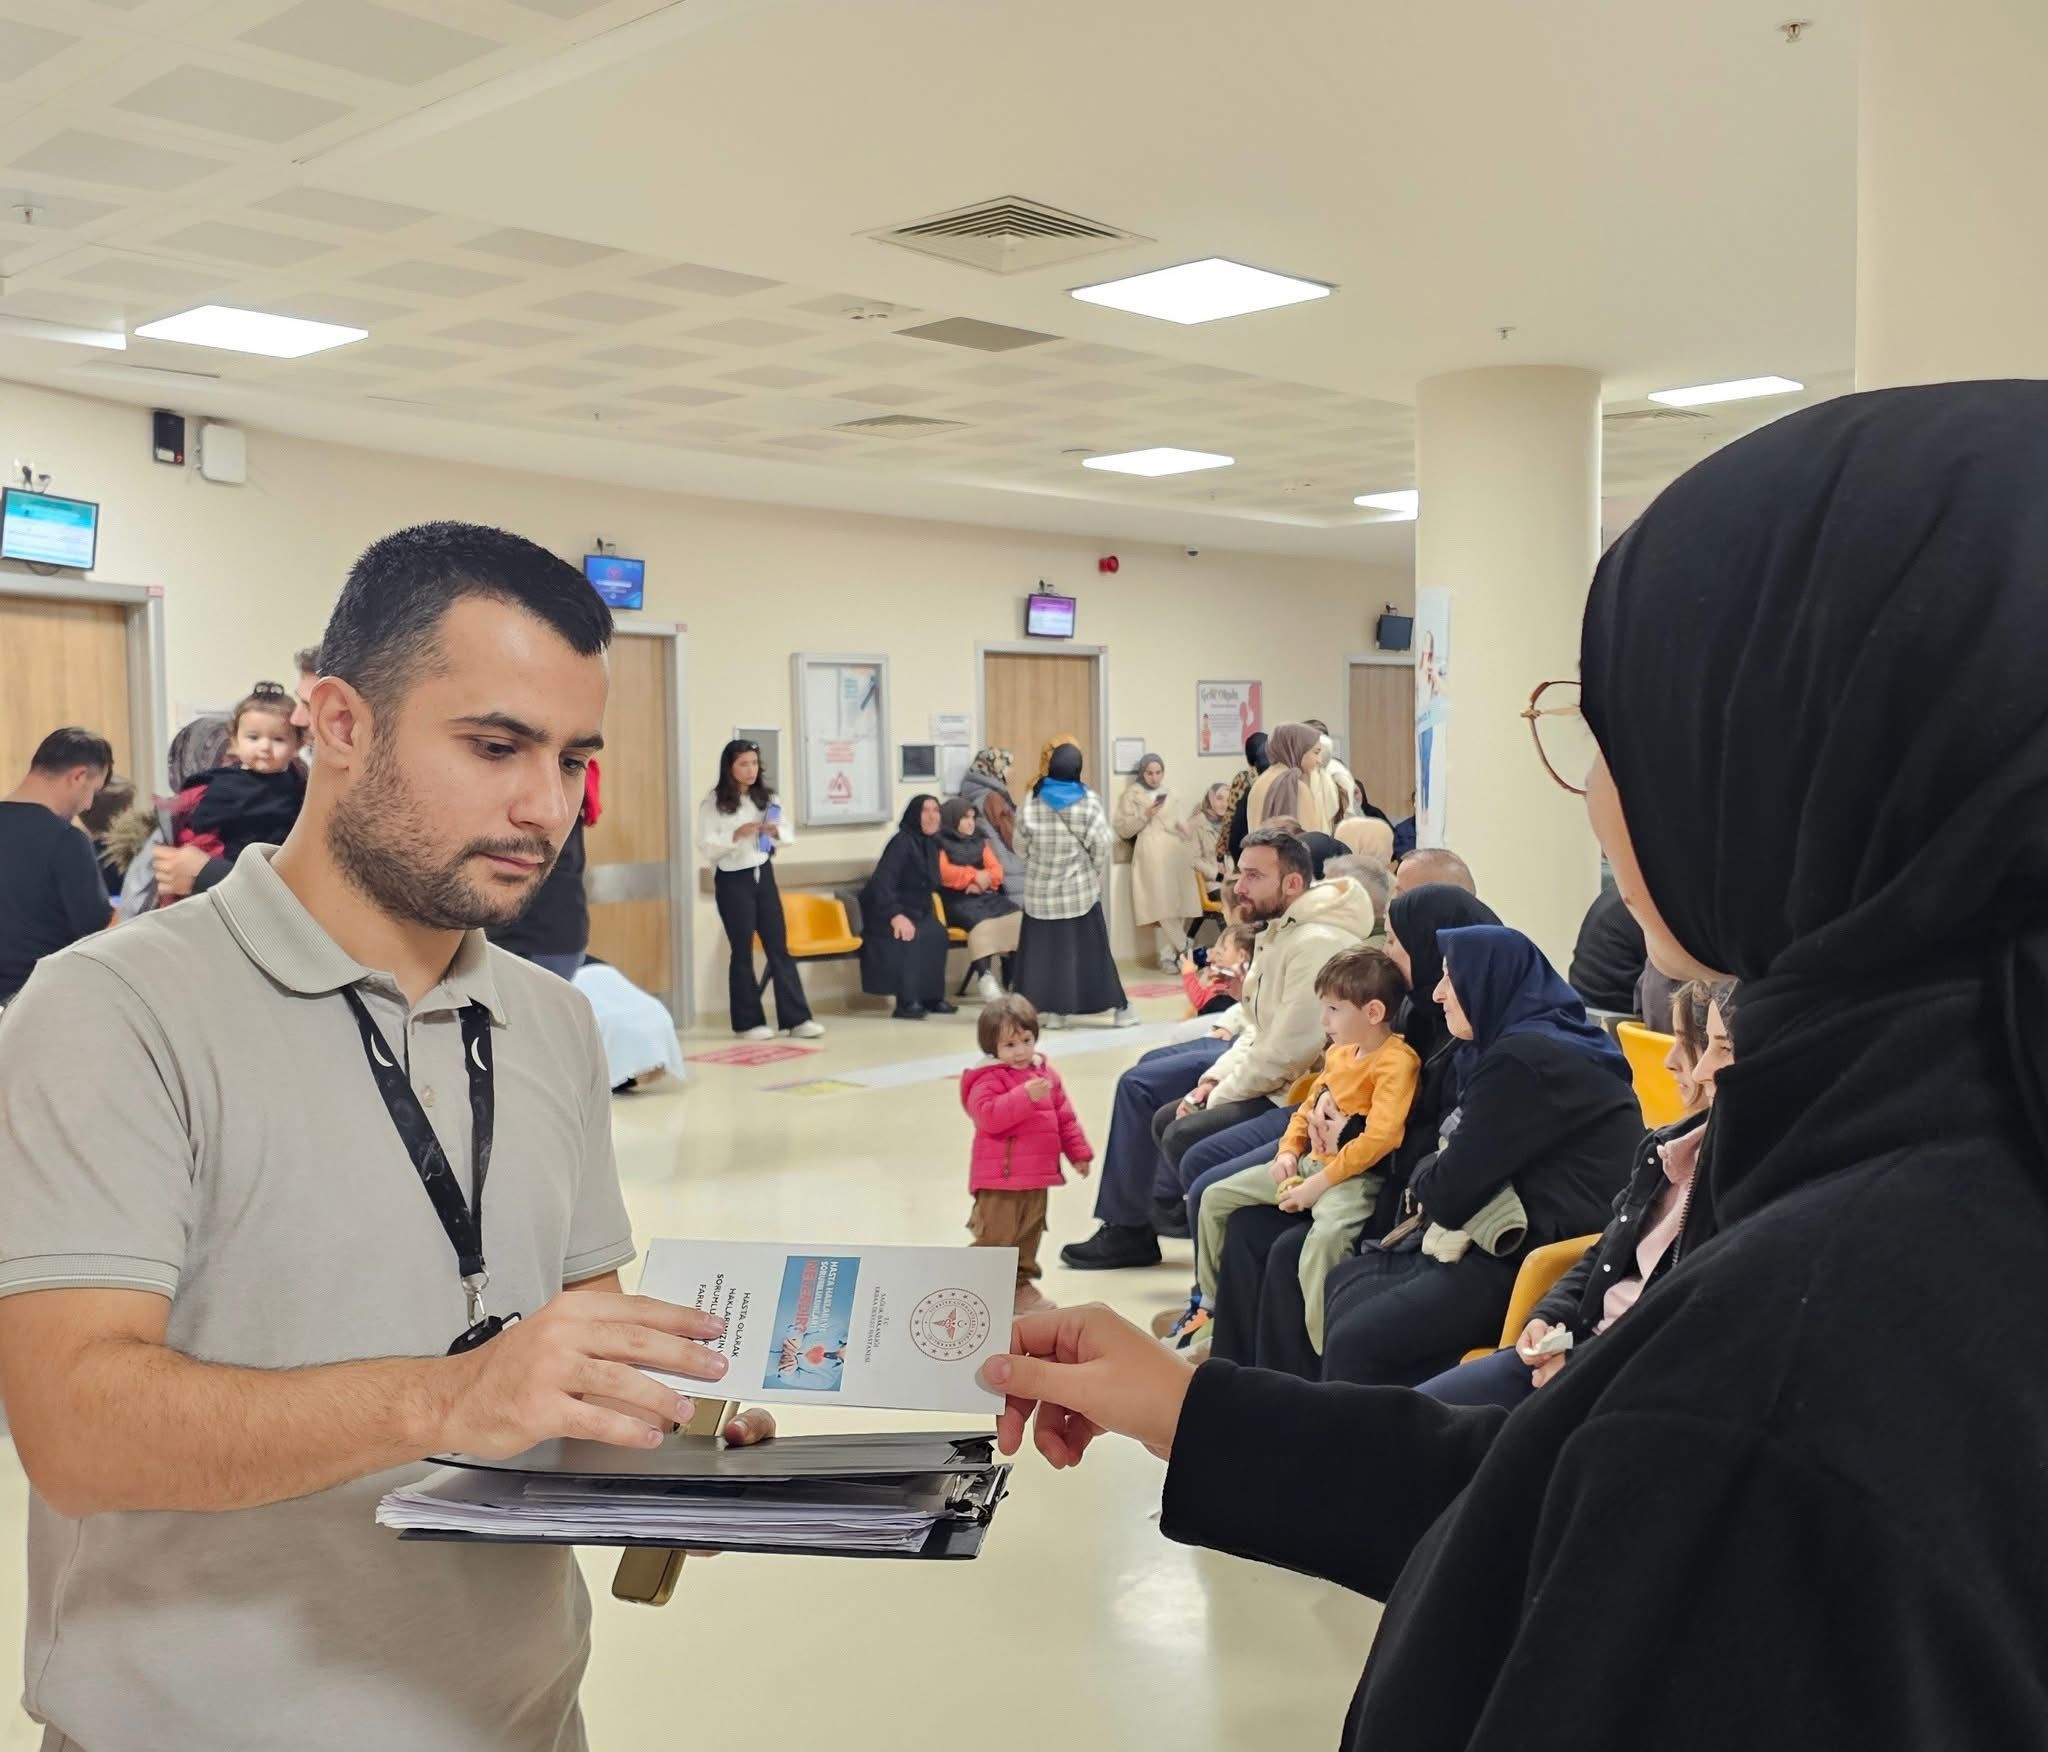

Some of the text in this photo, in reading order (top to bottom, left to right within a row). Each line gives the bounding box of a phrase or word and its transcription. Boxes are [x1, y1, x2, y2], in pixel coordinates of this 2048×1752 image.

[826, 1261, 839, 1287] HASTA
[731, 1292, 751, 1357] HASTA OLARAK
